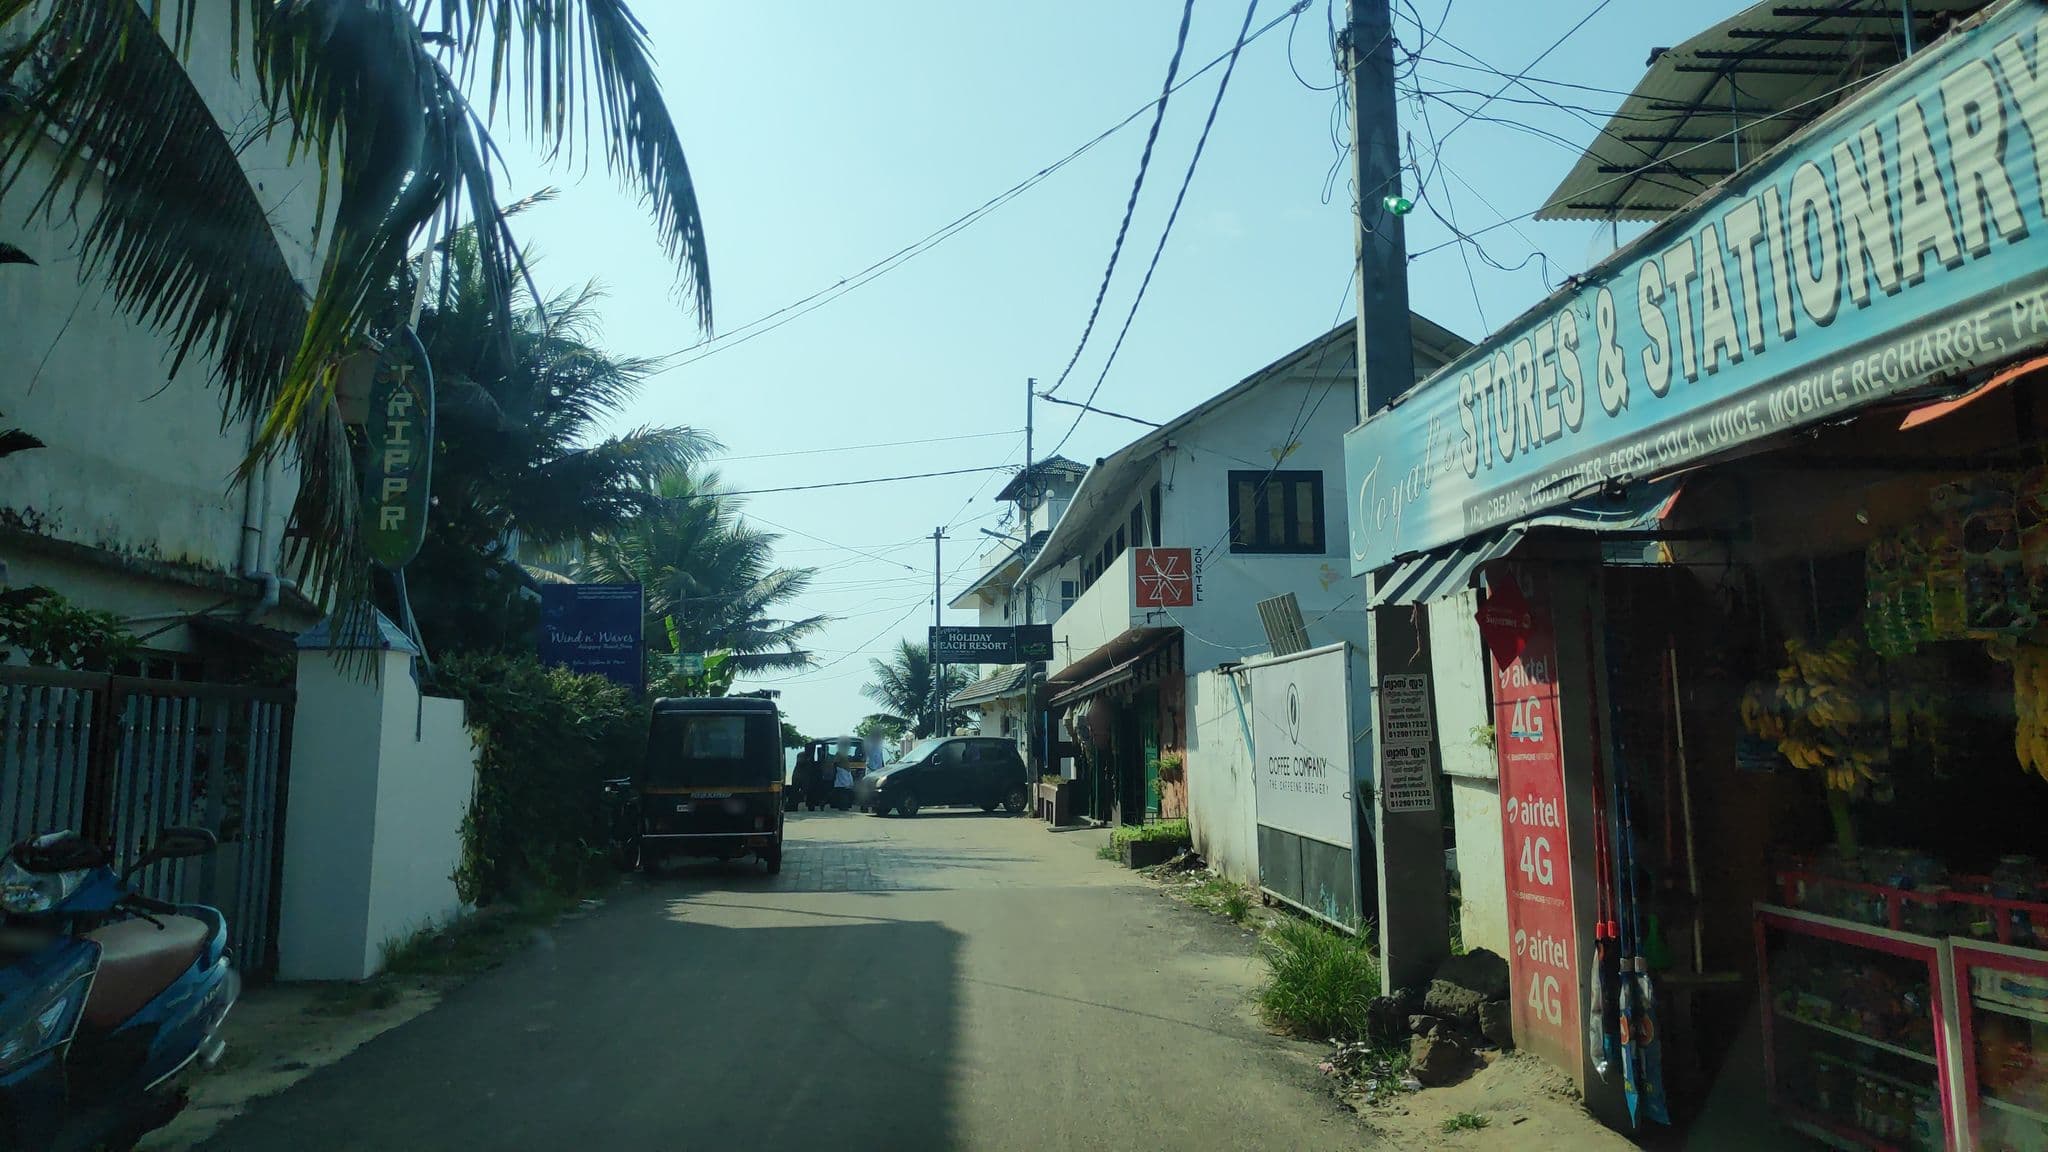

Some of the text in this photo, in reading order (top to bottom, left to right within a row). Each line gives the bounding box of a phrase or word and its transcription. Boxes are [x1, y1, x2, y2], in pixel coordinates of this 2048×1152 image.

[1458, 310, 1584, 479] STORES
[1596, 285, 1629, 418] &
[1637, 15, 2048, 398] STATIONARY
[1609, 441, 1655, 477] PEPSI,
[1655, 423, 1705, 462] COLA,
[1707, 400, 1766, 446] JUICE,
[1768, 366, 1848, 424] MOBILE
[1851, 311, 2007, 395] RECHARGE,
[1194, 548, 1204, 602] ZOSTEL
[599, 632, 633, 643] Waves
[948, 633, 992, 642] HOLIDAY
[969, 642, 1007, 650] RESORT
[1512, 656, 1550, 689] airtel
[1511, 696, 1543, 743] 4G
[1269, 756, 1327, 778] COFFEE COMPANY
[1520, 793, 1560, 827] airtel
[1520, 836, 1553, 886] 4G
[1529, 935, 1569, 970] airtel
[1528, 972, 1562, 1026] 4G
